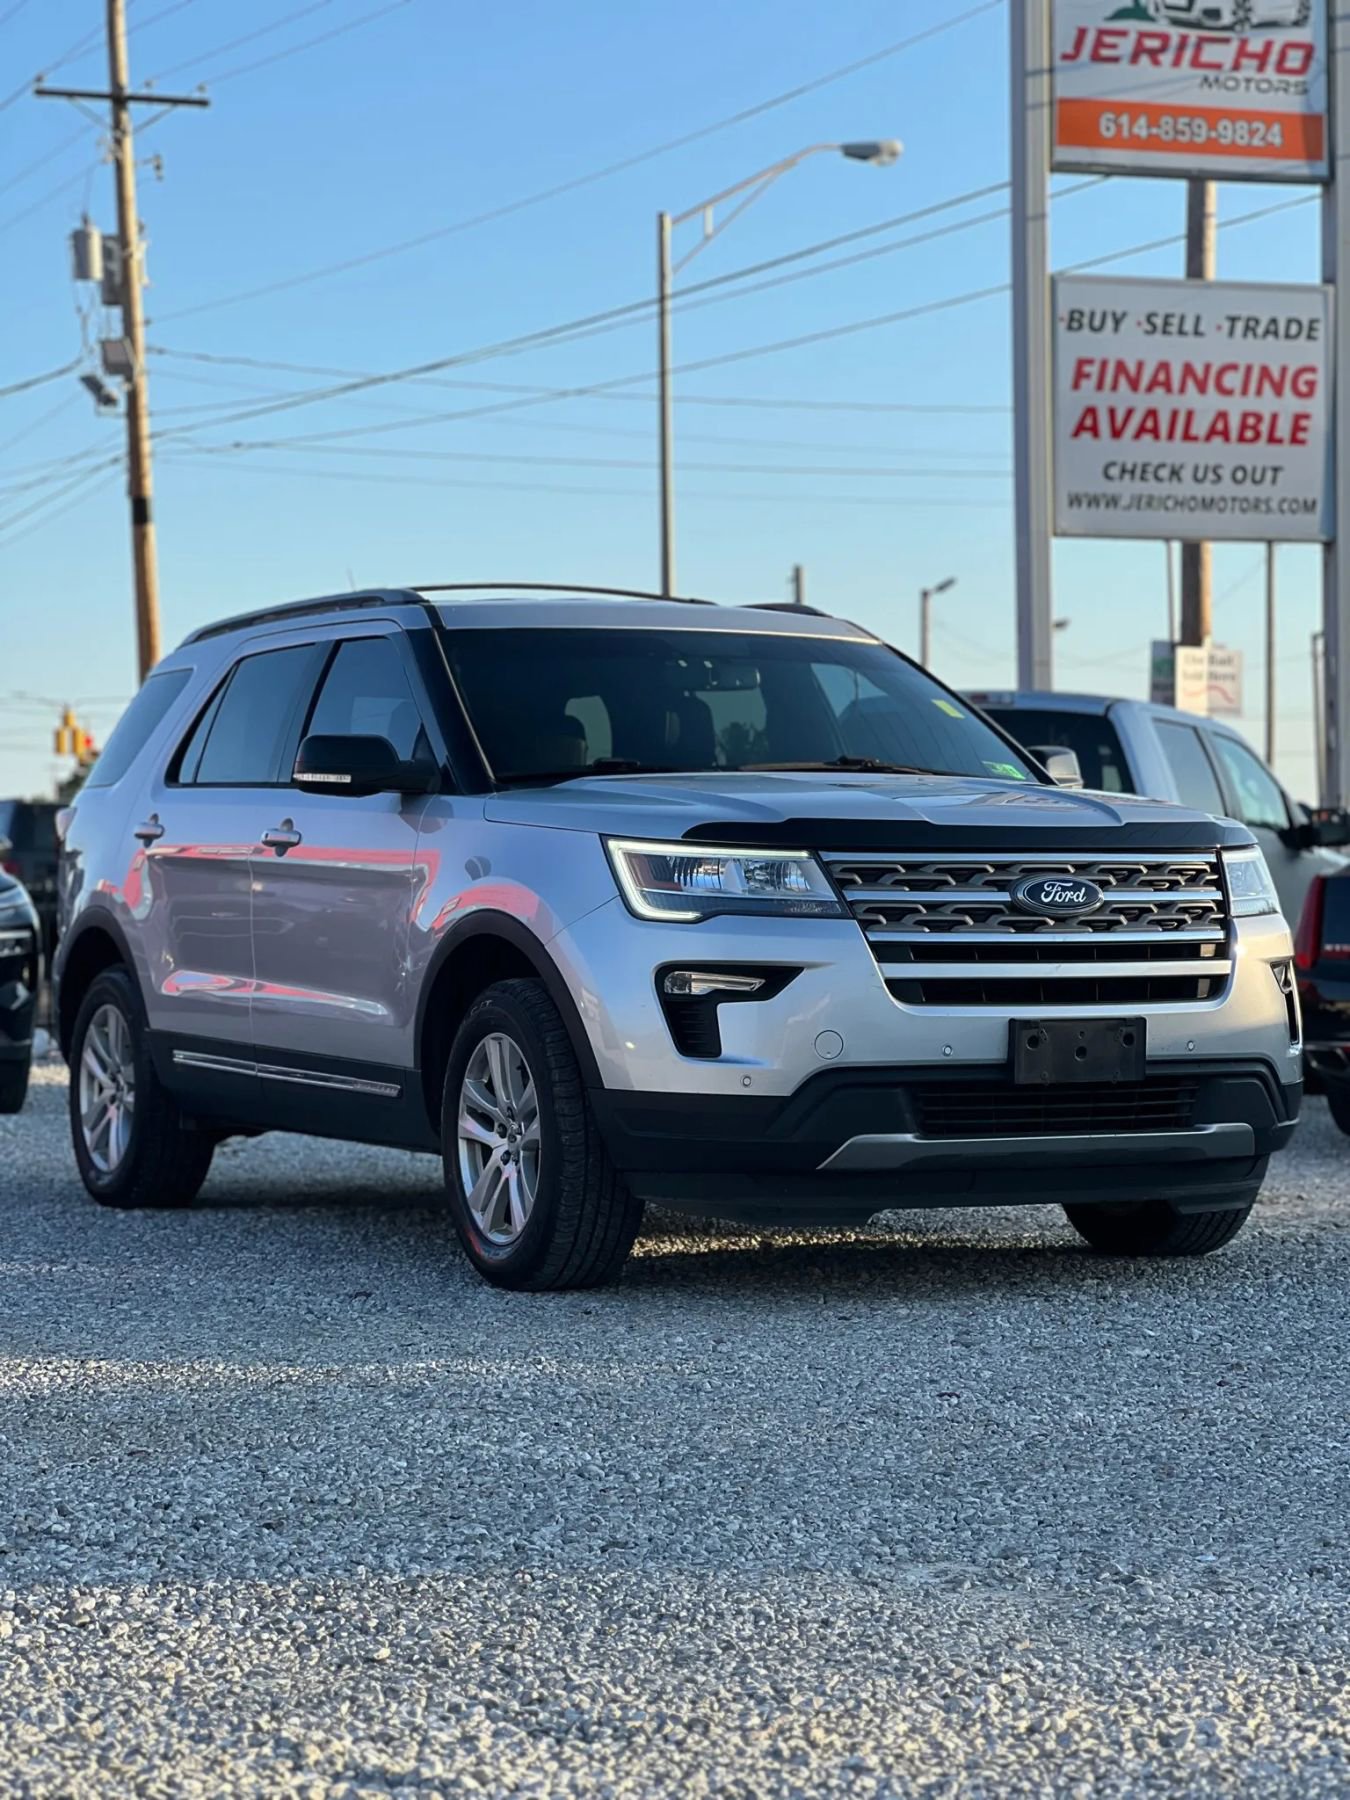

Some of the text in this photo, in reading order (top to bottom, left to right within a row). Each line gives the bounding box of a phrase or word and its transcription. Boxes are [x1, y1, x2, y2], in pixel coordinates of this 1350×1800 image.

[1060, 27, 1315, 76] JERICHO
[1199, 75, 1309, 96] MOTORS
[1099, 111, 1283, 148] 614-859-9824
[1070, 356, 1319, 400] FINANCING
[1070, 404, 1312, 446] AVAILABLE
[1102, 460, 1284, 486] CHECK US OUT
[1067, 490, 1318, 516] WWW.JERICHOMOTORS.COM
[1041, 881, 1087, 902] Ford
